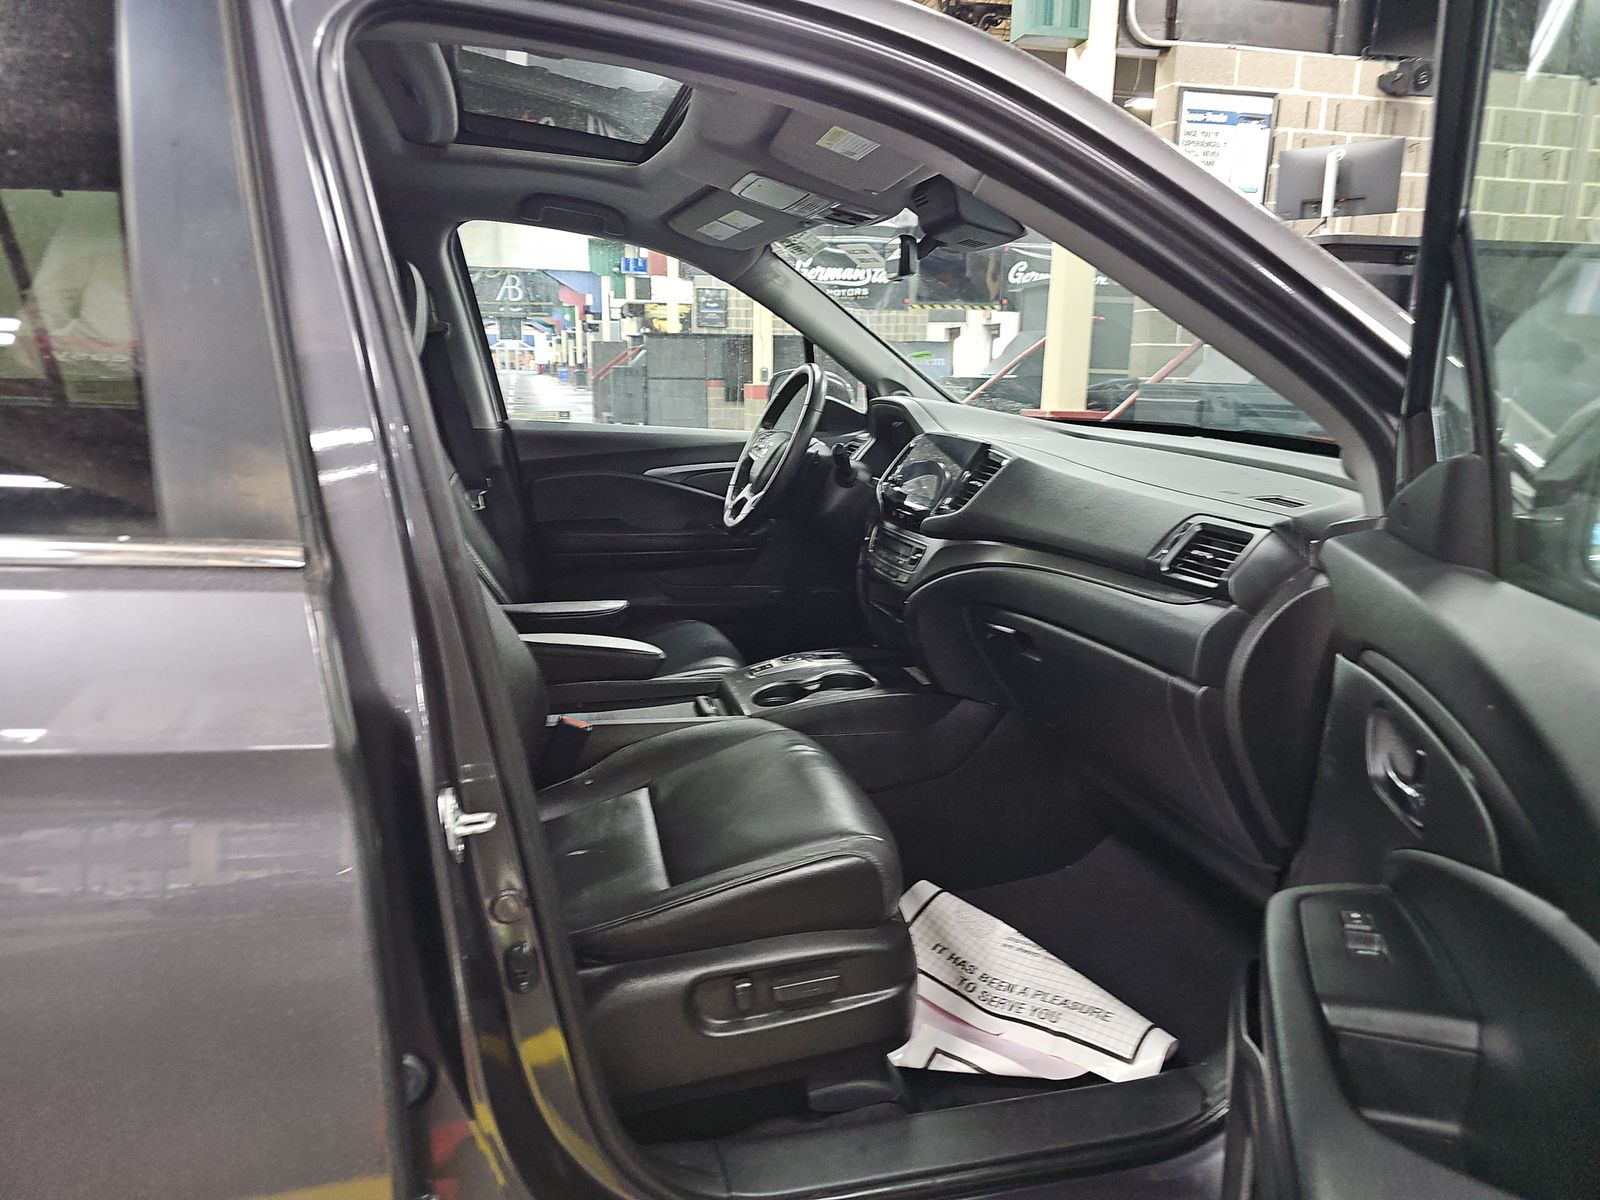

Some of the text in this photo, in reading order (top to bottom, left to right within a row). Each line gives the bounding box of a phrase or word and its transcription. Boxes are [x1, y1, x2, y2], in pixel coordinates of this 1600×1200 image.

[826, 288, 870, 296] MOTORS
[931, 943, 945, 955] IT
[949, 952, 978, 975] HAS
[979, 972, 1015, 994] BEEN
[1019, 985, 1031, 998] A
[1033, 989, 1115, 1023] PLEASURE
[957, 975, 1062, 1024] TO SERVE YOU
